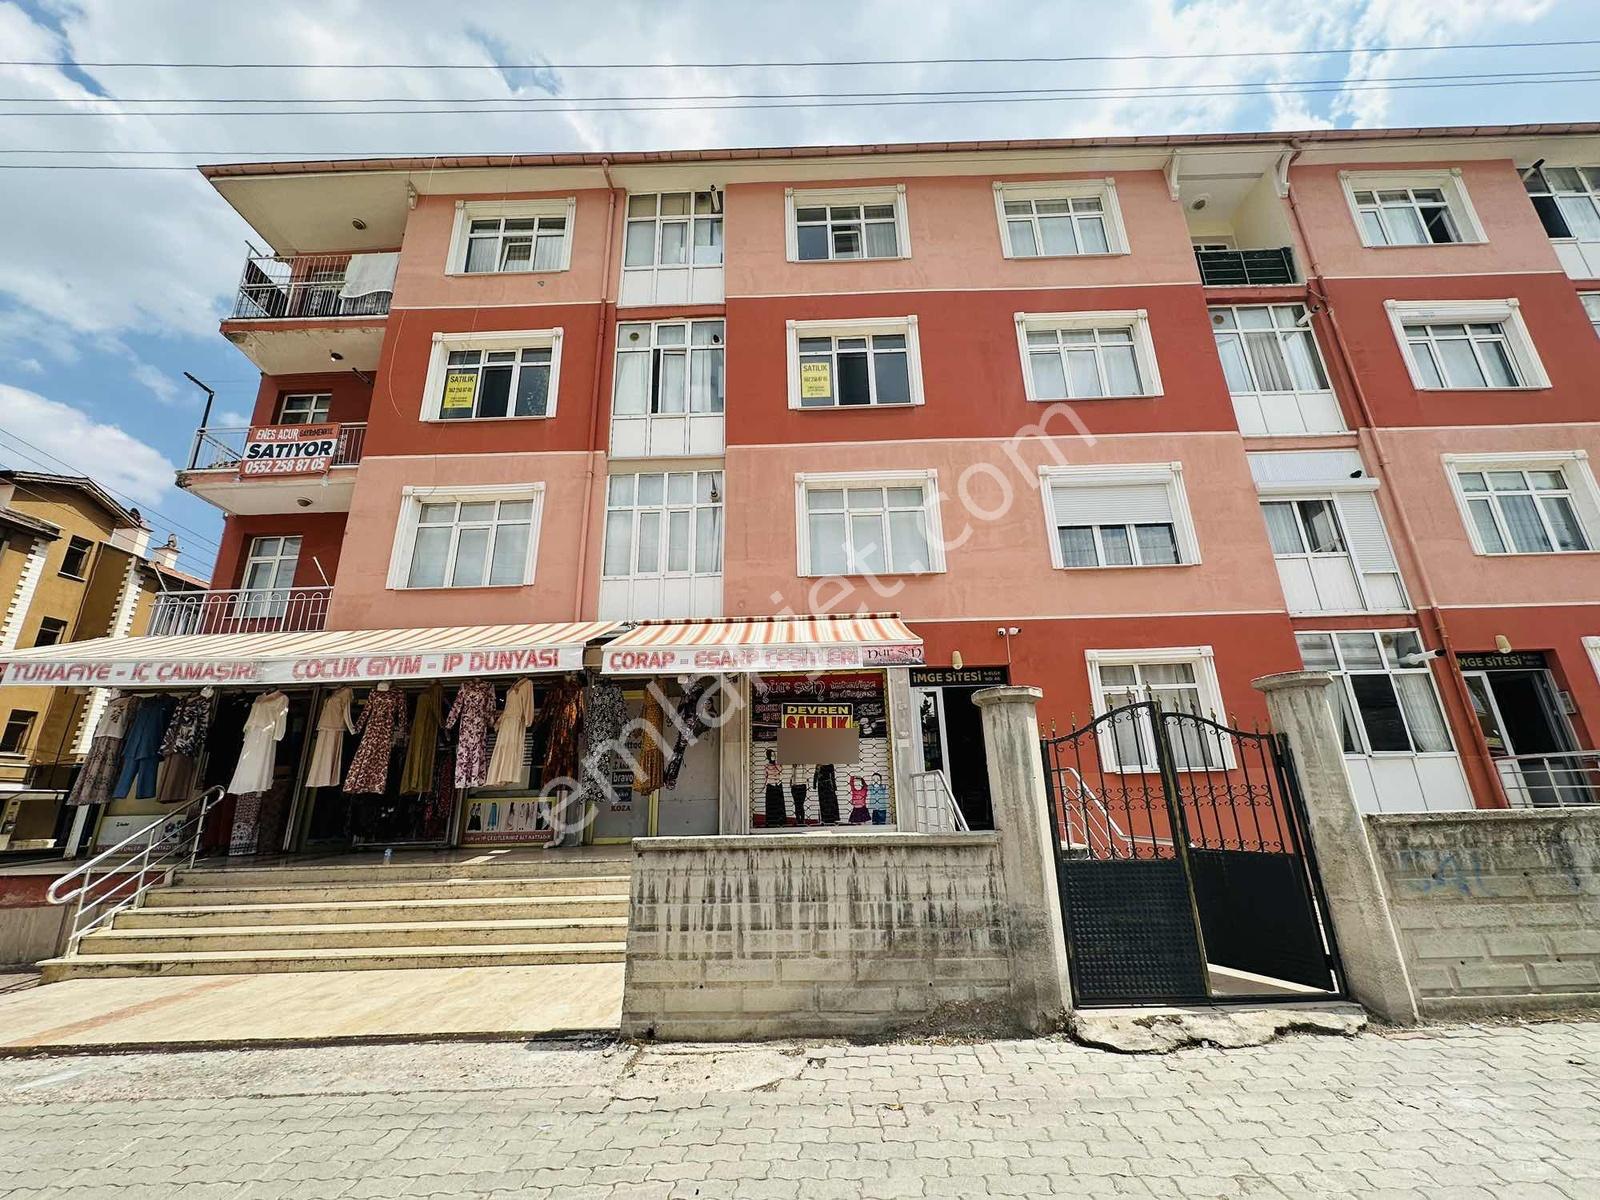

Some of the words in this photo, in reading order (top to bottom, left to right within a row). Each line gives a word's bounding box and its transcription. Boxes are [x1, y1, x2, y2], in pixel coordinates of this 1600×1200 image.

[803, 364, 828, 372] SATILIK
[450, 375, 475, 383] SATILIK
[247, 441, 333, 459] SATIYOR
[245, 461, 272, 474] 0552
[273, 460, 294, 472] 258
[295, 459, 311, 471] 87
[311, 458, 326, 470] 05
[609, 650, 676, 671] ÇORAP
[787, 706, 849, 714] DEVREN
[613, 771, 634, 783] bravo
